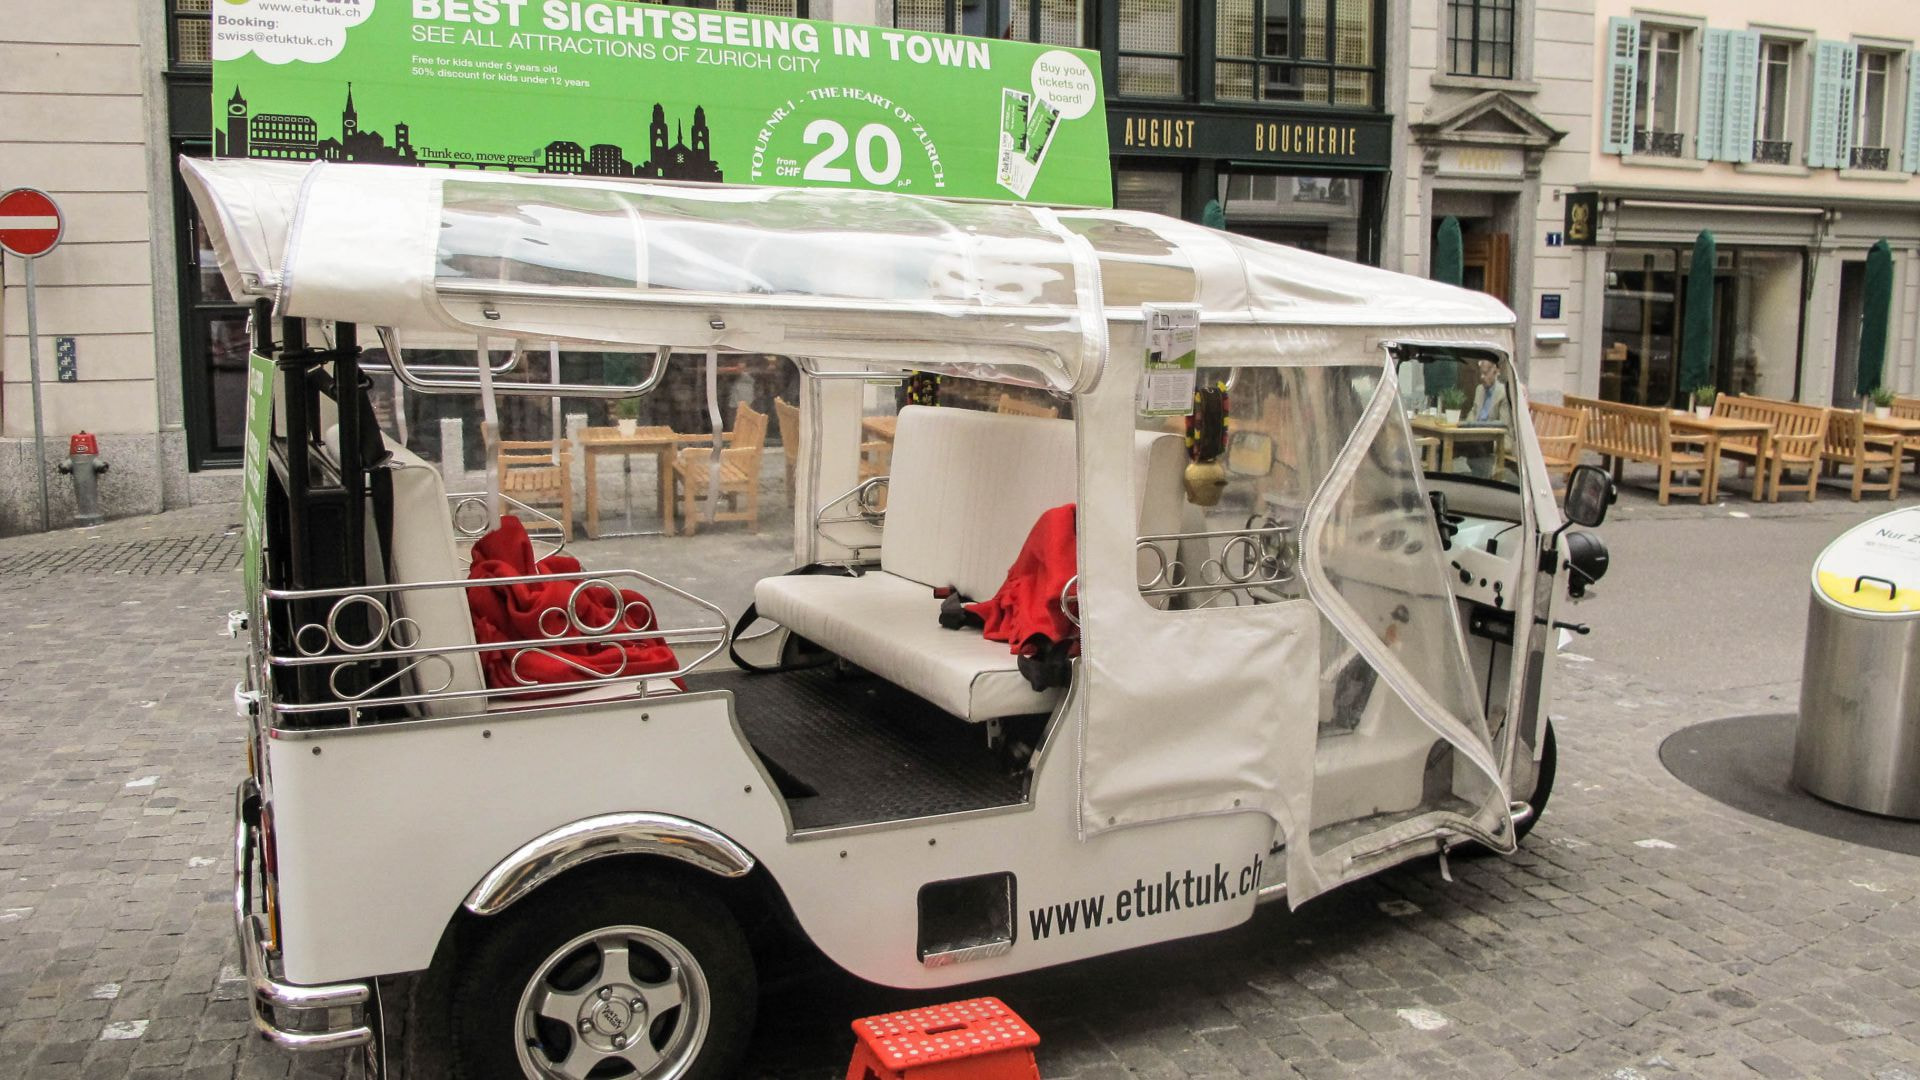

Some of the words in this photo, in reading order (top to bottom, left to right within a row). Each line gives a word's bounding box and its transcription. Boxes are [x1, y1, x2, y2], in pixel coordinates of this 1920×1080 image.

[258, 3, 361, 18] www.etuktuk.ch
[218, 15, 279, 29] Booking:
[218, 32, 333, 47] swiss@etuktuk.ch
[412, 0, 528, 26] BEST
[542, 0, 820, 53] SIGHTSEEING
[832, 27, 870, 58] IN
[882, 32, 991, 70] TOWN
[412, 24, 456, 44] SEE
[462, 29, 502, 48] ALL
[508, 32, 656, 60] ATTRACTIONS
[662, 45, 690, 62] OF
[696, 48, 772, 70] ZURICH
[778, 55, 820, 74] CITY
[412, 55, 434, 65] Free
[436, 56, 450, 66] for
[452, 58, 473, 68] kids
[476, 61, 503, 70] under
[506, 62, 513, 70] 5
[514, 64, 540, 74] years
[543, 63, 558, 74] old
[1040, 62, 1061, 76] Buy
[1063, 67, 1087, 77] your
[412, 66, 434, 77] 50%
[437, 68, 480, 80] discount
[482, 70, 496, 80] for
[498, 72, 518, 82] kids
[520, 74, 548, 84] under
[551, 76, 562, 86] 12
[564, 79, 590, 88] years
[1039, 77, 1074, 89] tickets
[1076, 82, 1090, 91] on
[1048, 90, 1082, 104] board!
[752, 128, 773, 182] TOUR
[806, 87, 841, 101] THE
[842, 87, 894, 110] HEART
[894, 107, 916, 125] OF
[912, 123, 945, 188] ZURICH
[1124, 118, 1195, 148] AUGUST
[1256, 123, 1356, 156] BOUCHERIE
[420, 147, 452, 159] Think
[454, 152, 474, 162] eco,
[476, 152, 505, 162] move
[507, 154, 536, 166] green
[776, 166, 801, 177] CHF
[802, 119, 902, 186] 20
[776, 157, 797, 166] from
[1876, 528, 1906, 540] Nur
[1029, 853, 1263, 941] www.etuktuk.ch
